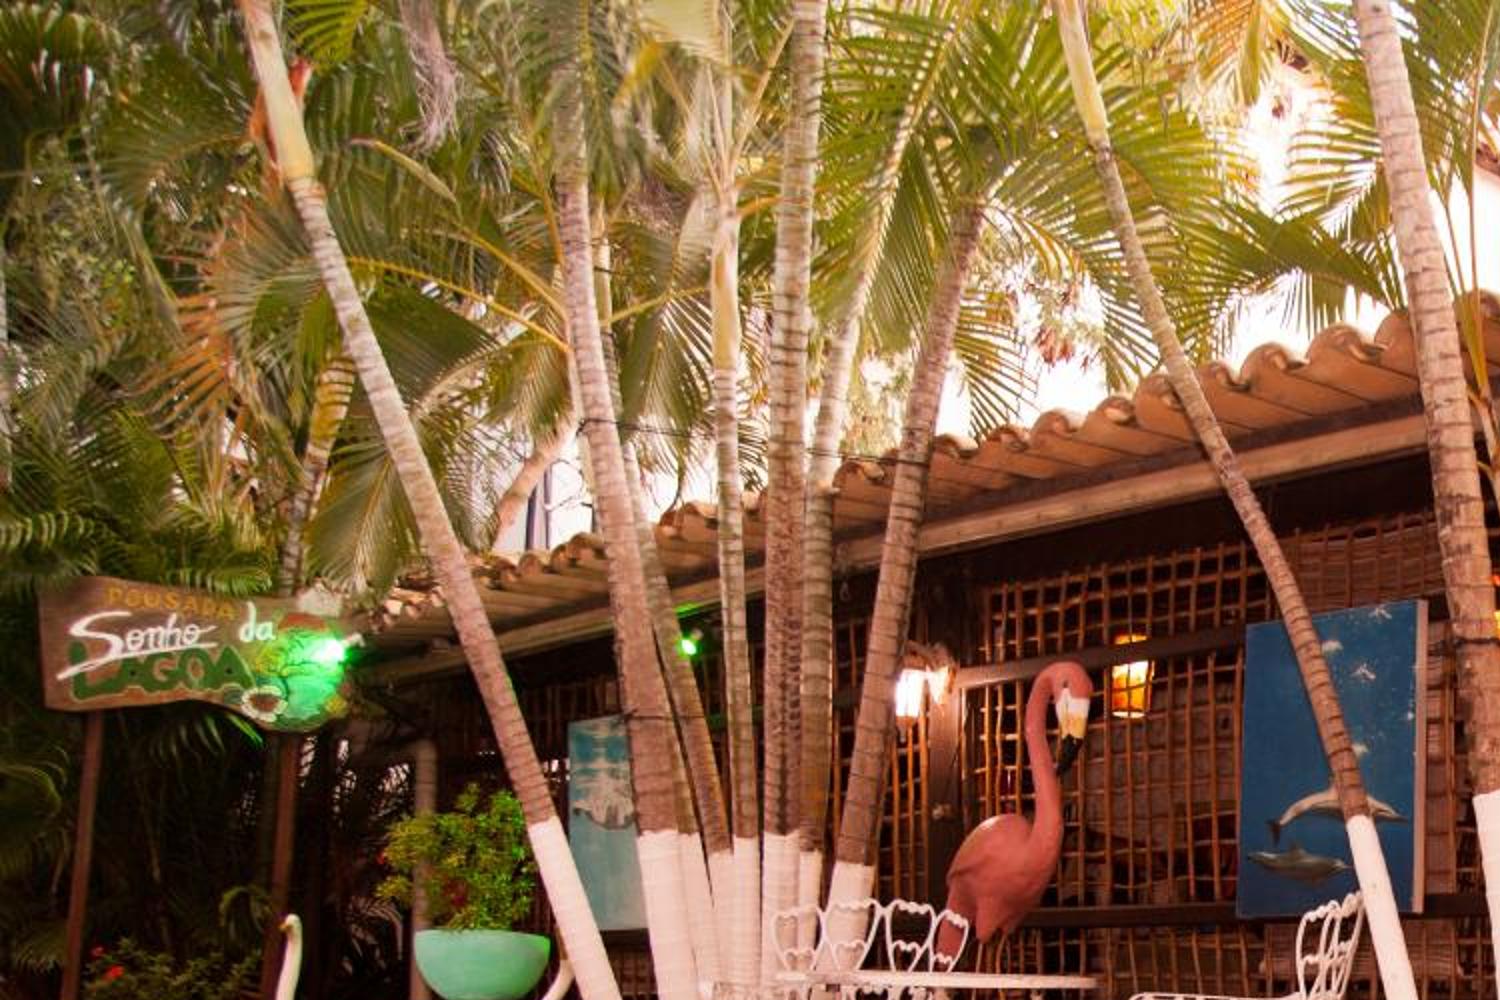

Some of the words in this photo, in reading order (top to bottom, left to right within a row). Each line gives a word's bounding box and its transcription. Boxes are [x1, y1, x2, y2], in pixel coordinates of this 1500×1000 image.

[108, 587, 236, 620] POUSADA
[57, 610, 218, 681] Sonho
[239, 600, 278, 643] da
[69, 640, 256, 700] LAGOA
